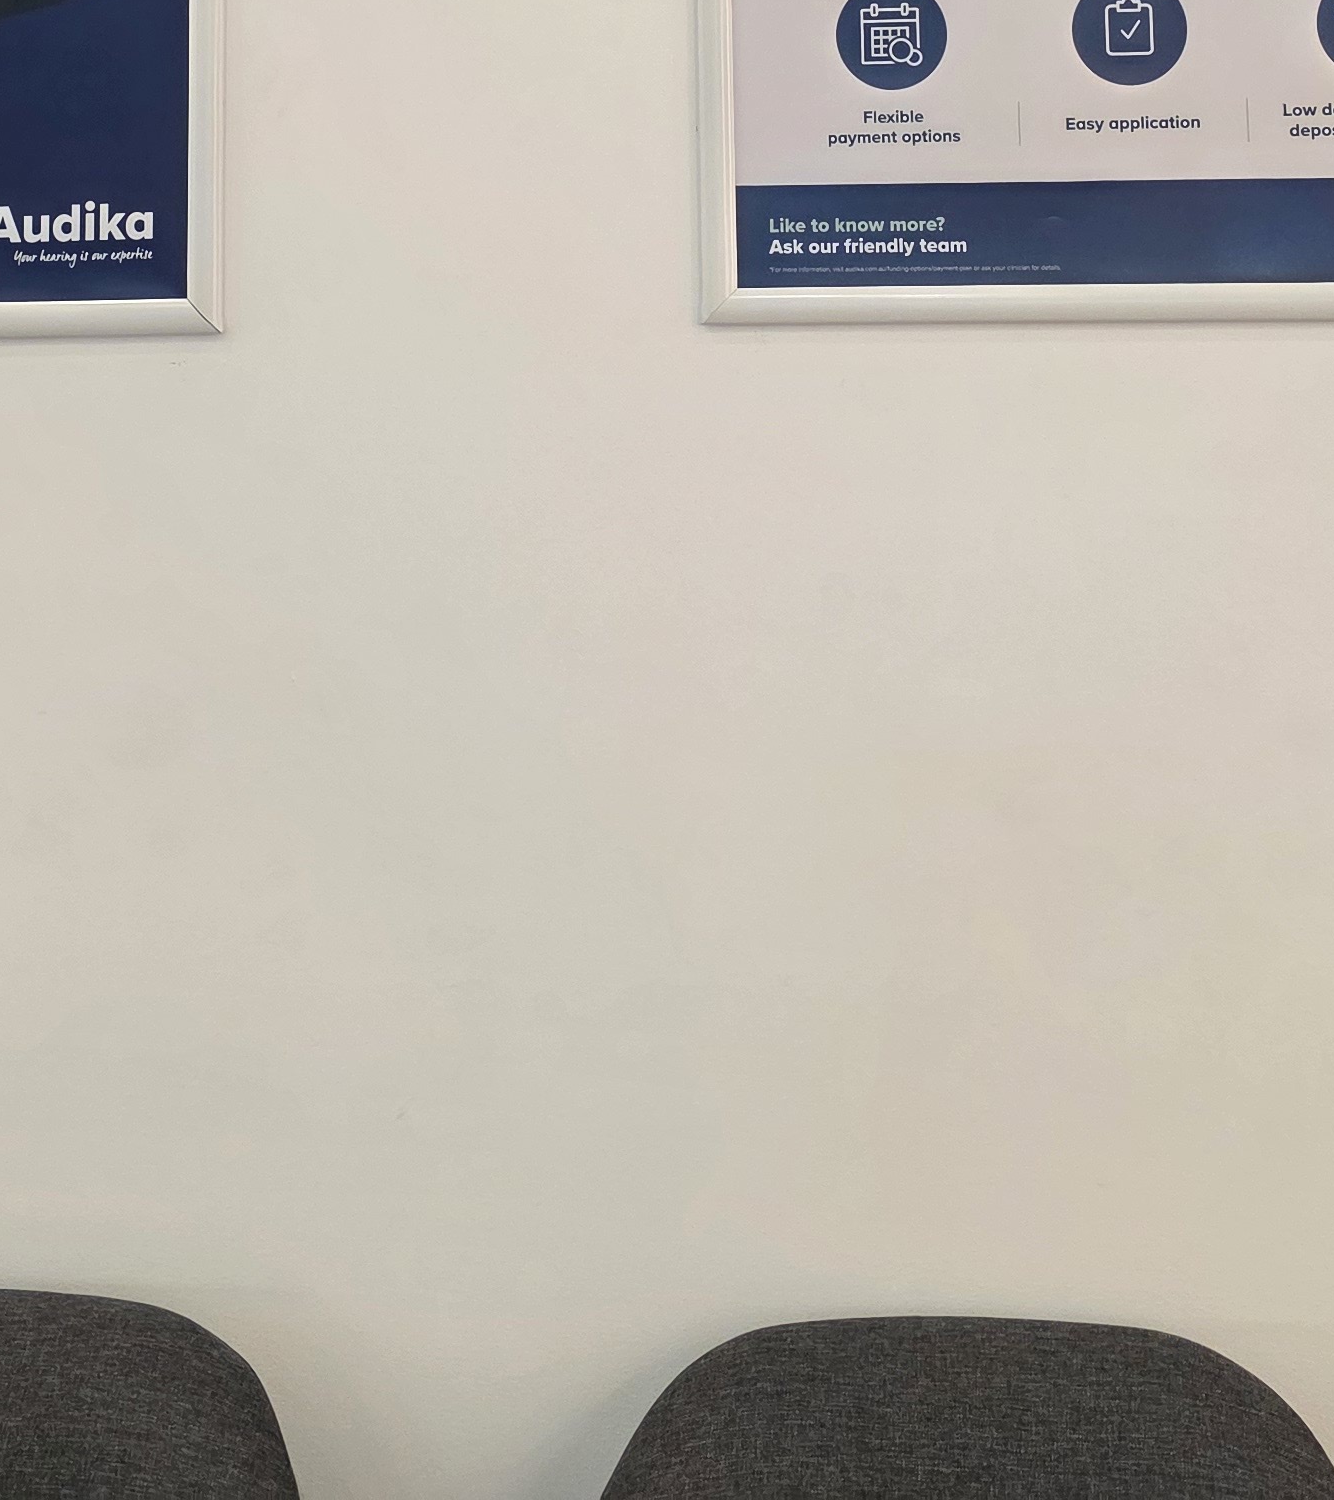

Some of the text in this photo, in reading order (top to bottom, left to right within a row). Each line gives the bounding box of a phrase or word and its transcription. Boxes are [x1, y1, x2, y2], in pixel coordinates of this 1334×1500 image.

[864, 110, 924, 124] Flexible
[1283, 103, 1317, 116] Low
[1066, 115, 1200, 133] Easy application
[828, 129, 961, 147] payment options
[770, 217, 945, 233] Like to know more?
[769, 237, 967, 256] Ask our friendly team
[14, 250, 37, 266] Your
[40, 249, 77, 268] hearing
[80, 251, 89, 261] is
[111, 247, 152, 263] expertise
